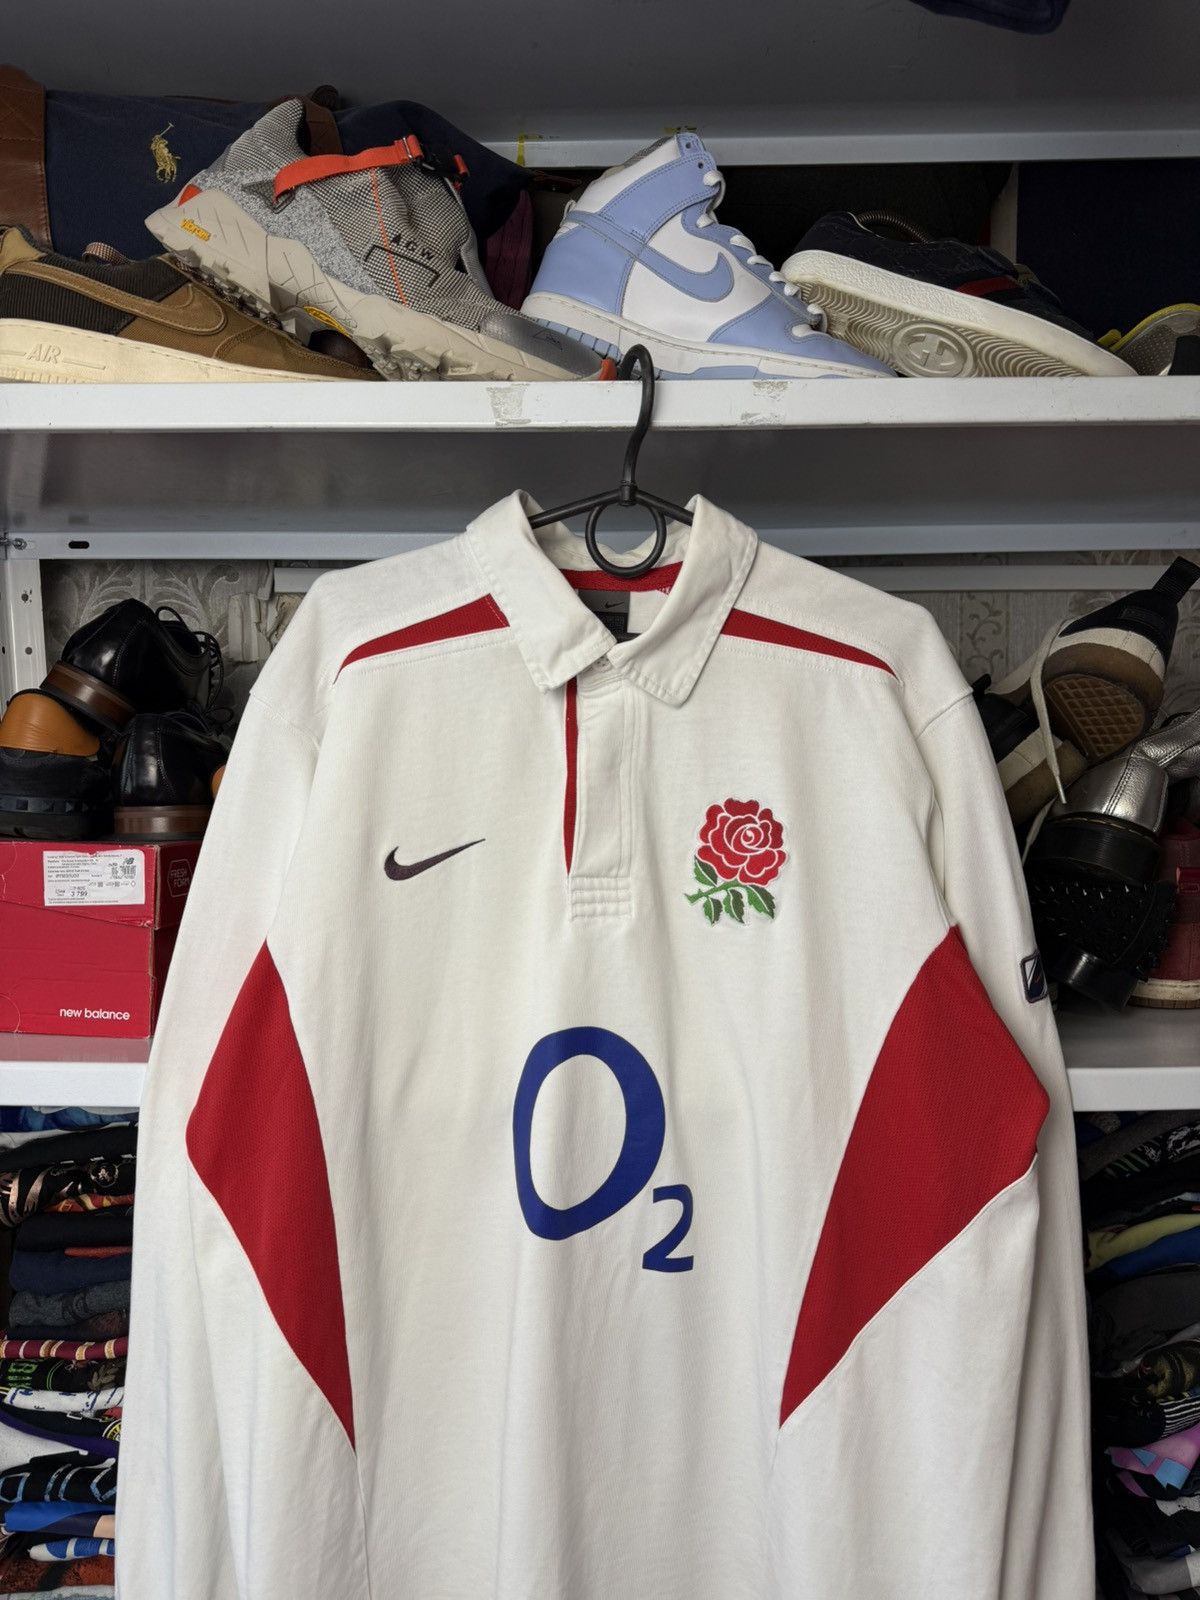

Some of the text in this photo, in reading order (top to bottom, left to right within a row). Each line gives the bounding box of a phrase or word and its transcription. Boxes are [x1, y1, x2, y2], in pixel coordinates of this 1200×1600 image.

[27, 343, 61, 364] AIR
[59, 1007, 130, 1020] new balance
